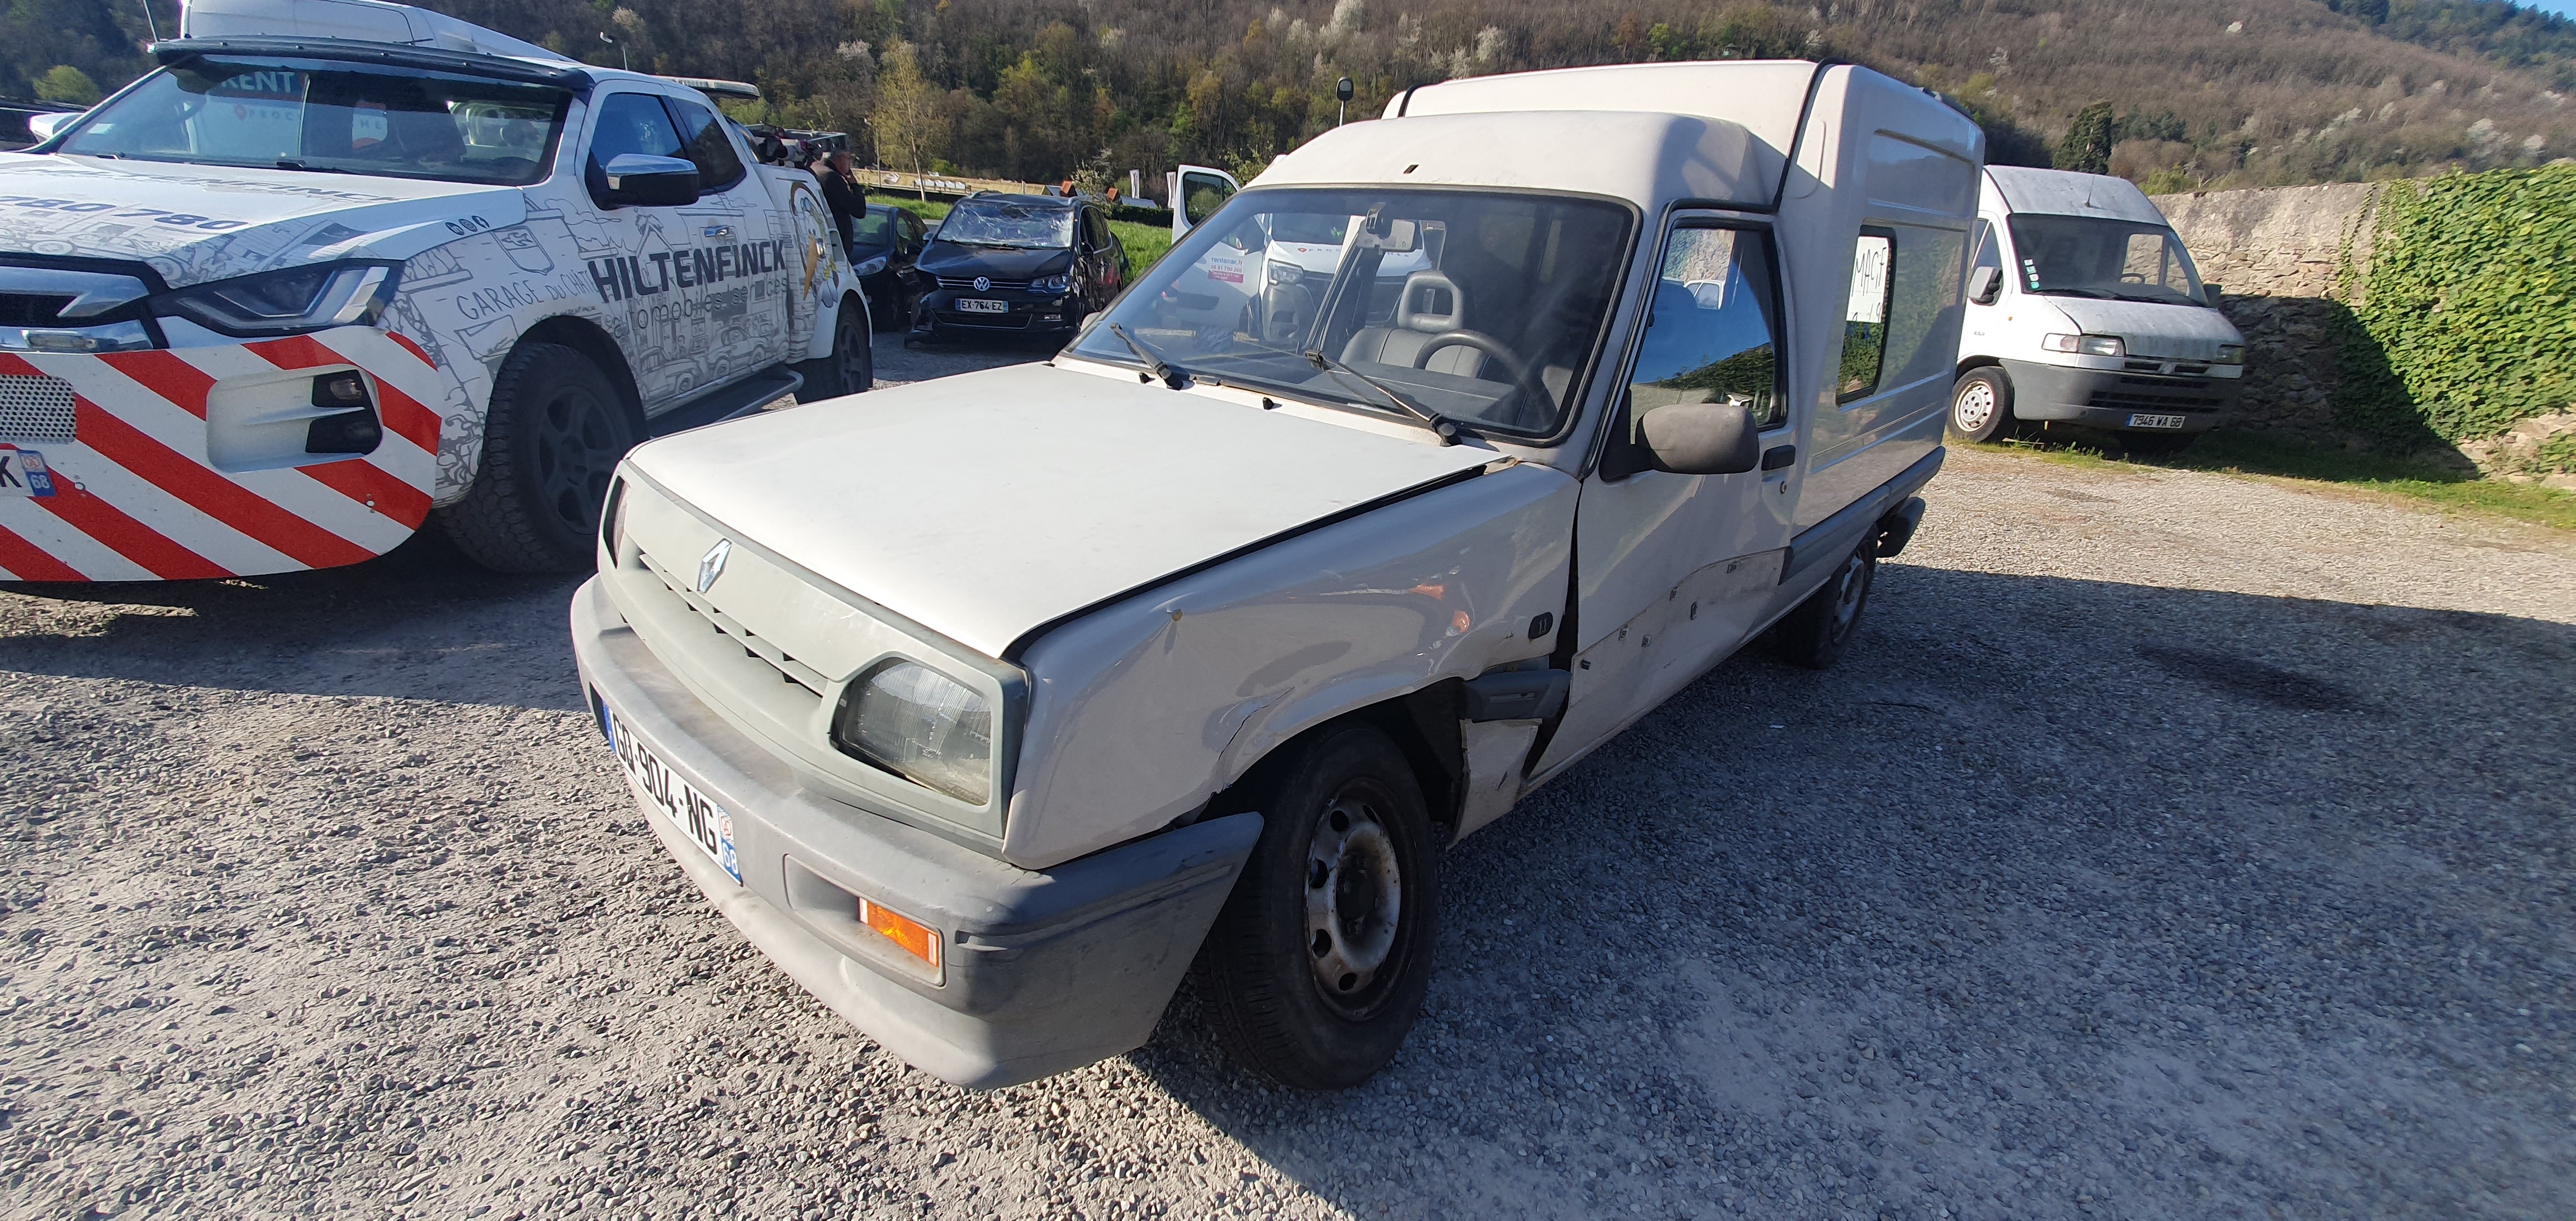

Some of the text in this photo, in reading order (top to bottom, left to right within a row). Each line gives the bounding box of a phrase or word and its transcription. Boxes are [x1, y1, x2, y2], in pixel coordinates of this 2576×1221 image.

[112, 209, 249, 230] 780
[588, 239, 786, 303] HILTENFINCK
[456, 280, 543, 320] GARAGE
[545, 285, 566, 300] DU
[31, 474, 50, 489] 68
[722, 841, 739, 875] 68
